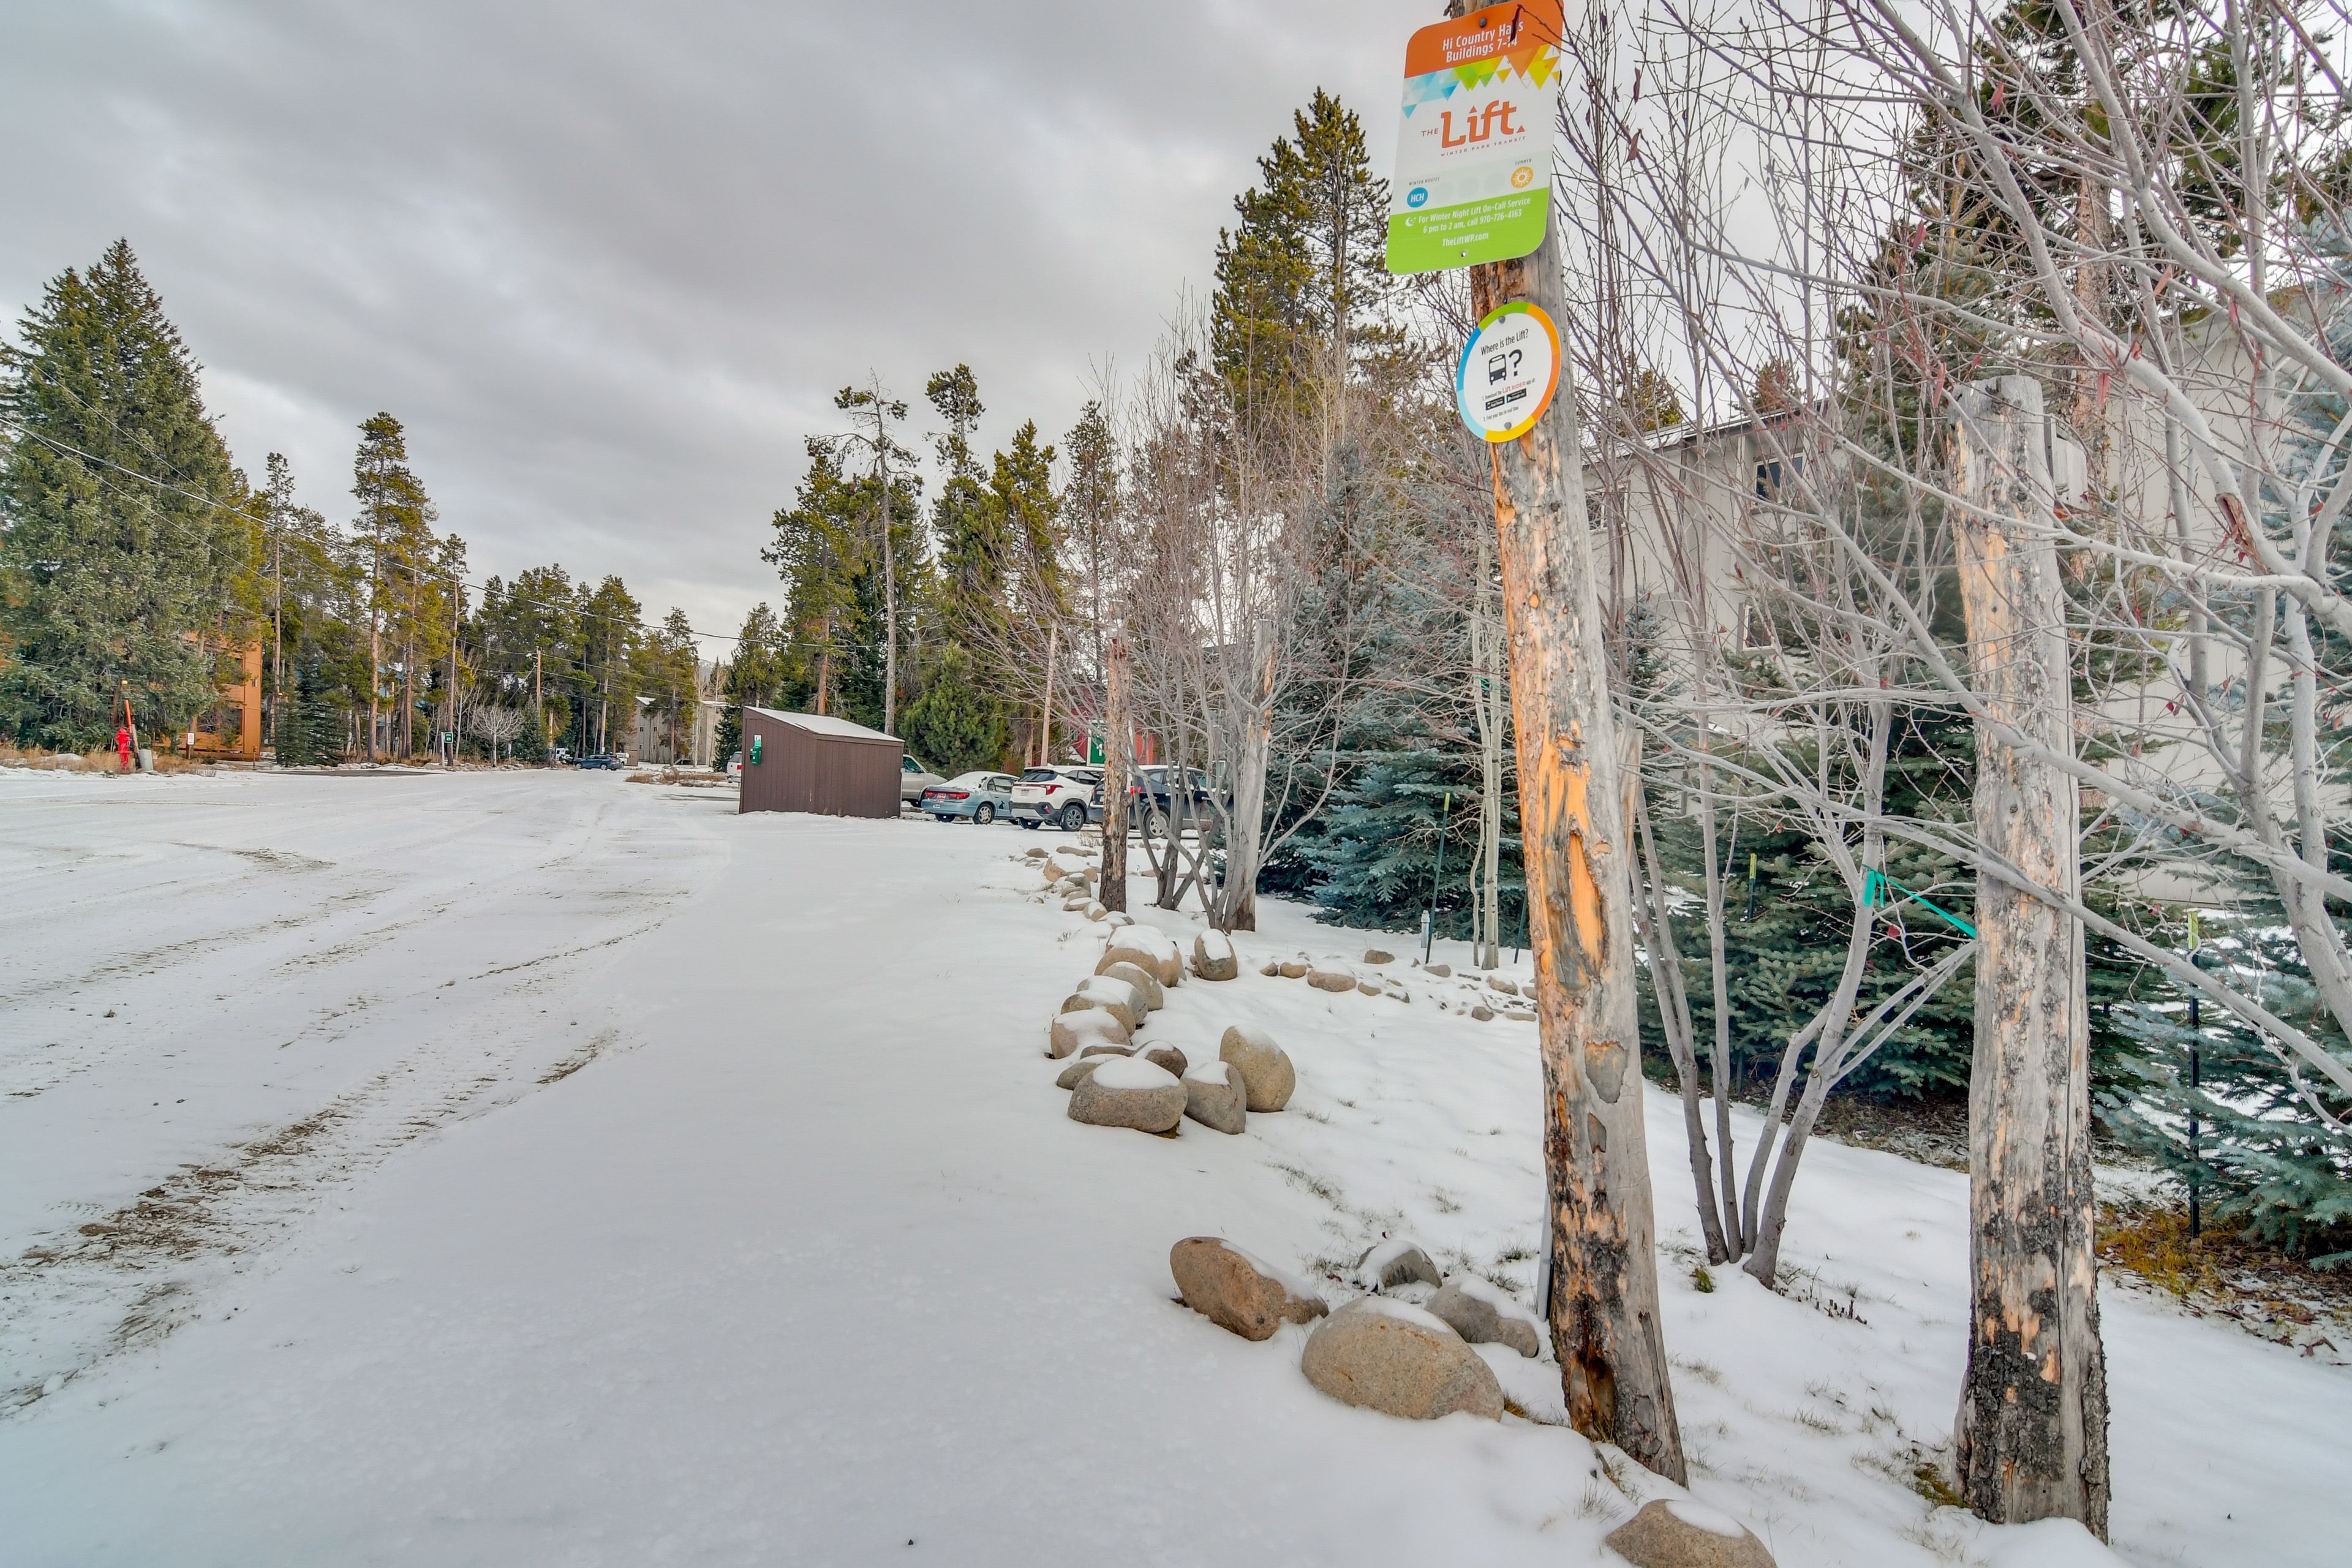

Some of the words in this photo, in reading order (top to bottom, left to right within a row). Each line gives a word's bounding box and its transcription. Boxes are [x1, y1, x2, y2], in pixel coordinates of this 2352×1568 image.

[1442, 38, 1453, 51] Hi
[1456, 29, 1496, 47] Country
[1499, 21, 1523, 37] Has
[1446, 42, 1493, 63] Buildings
[1497, 35, 1518, 50] 7-14
[1421, 127, 1439, 137] THE
[1441, 148, 1468, 157] WINTER
[1494, 136, 1526, 146] TRANSIT
[1411, 193, 1425, 203] HCH
[1418, 215, 1428, 224] For
[1430, 212, 1451, 223] Winter
[1452, 209, 1469, 219] Night
[1471, 206, 1481, 214] Lift
[1483, 203, 1506, 213] On-Call
[1508, 197, 1531, 208] Service
[1428, 224, 1439, 234] pm
[1441, 222, 1447, 231] to
[1453, 221, 1466, 230] am,
[1467, 217, 1478, 226] call
[1442, 232, 1489, 246] TheLiftWP.com
[1480, 342, 1499, 356] Where
[1499, 339, 1504, 348] is
[1506, 336, 1515, 346] the
[1516, 328, 1529, 342] Lift?
